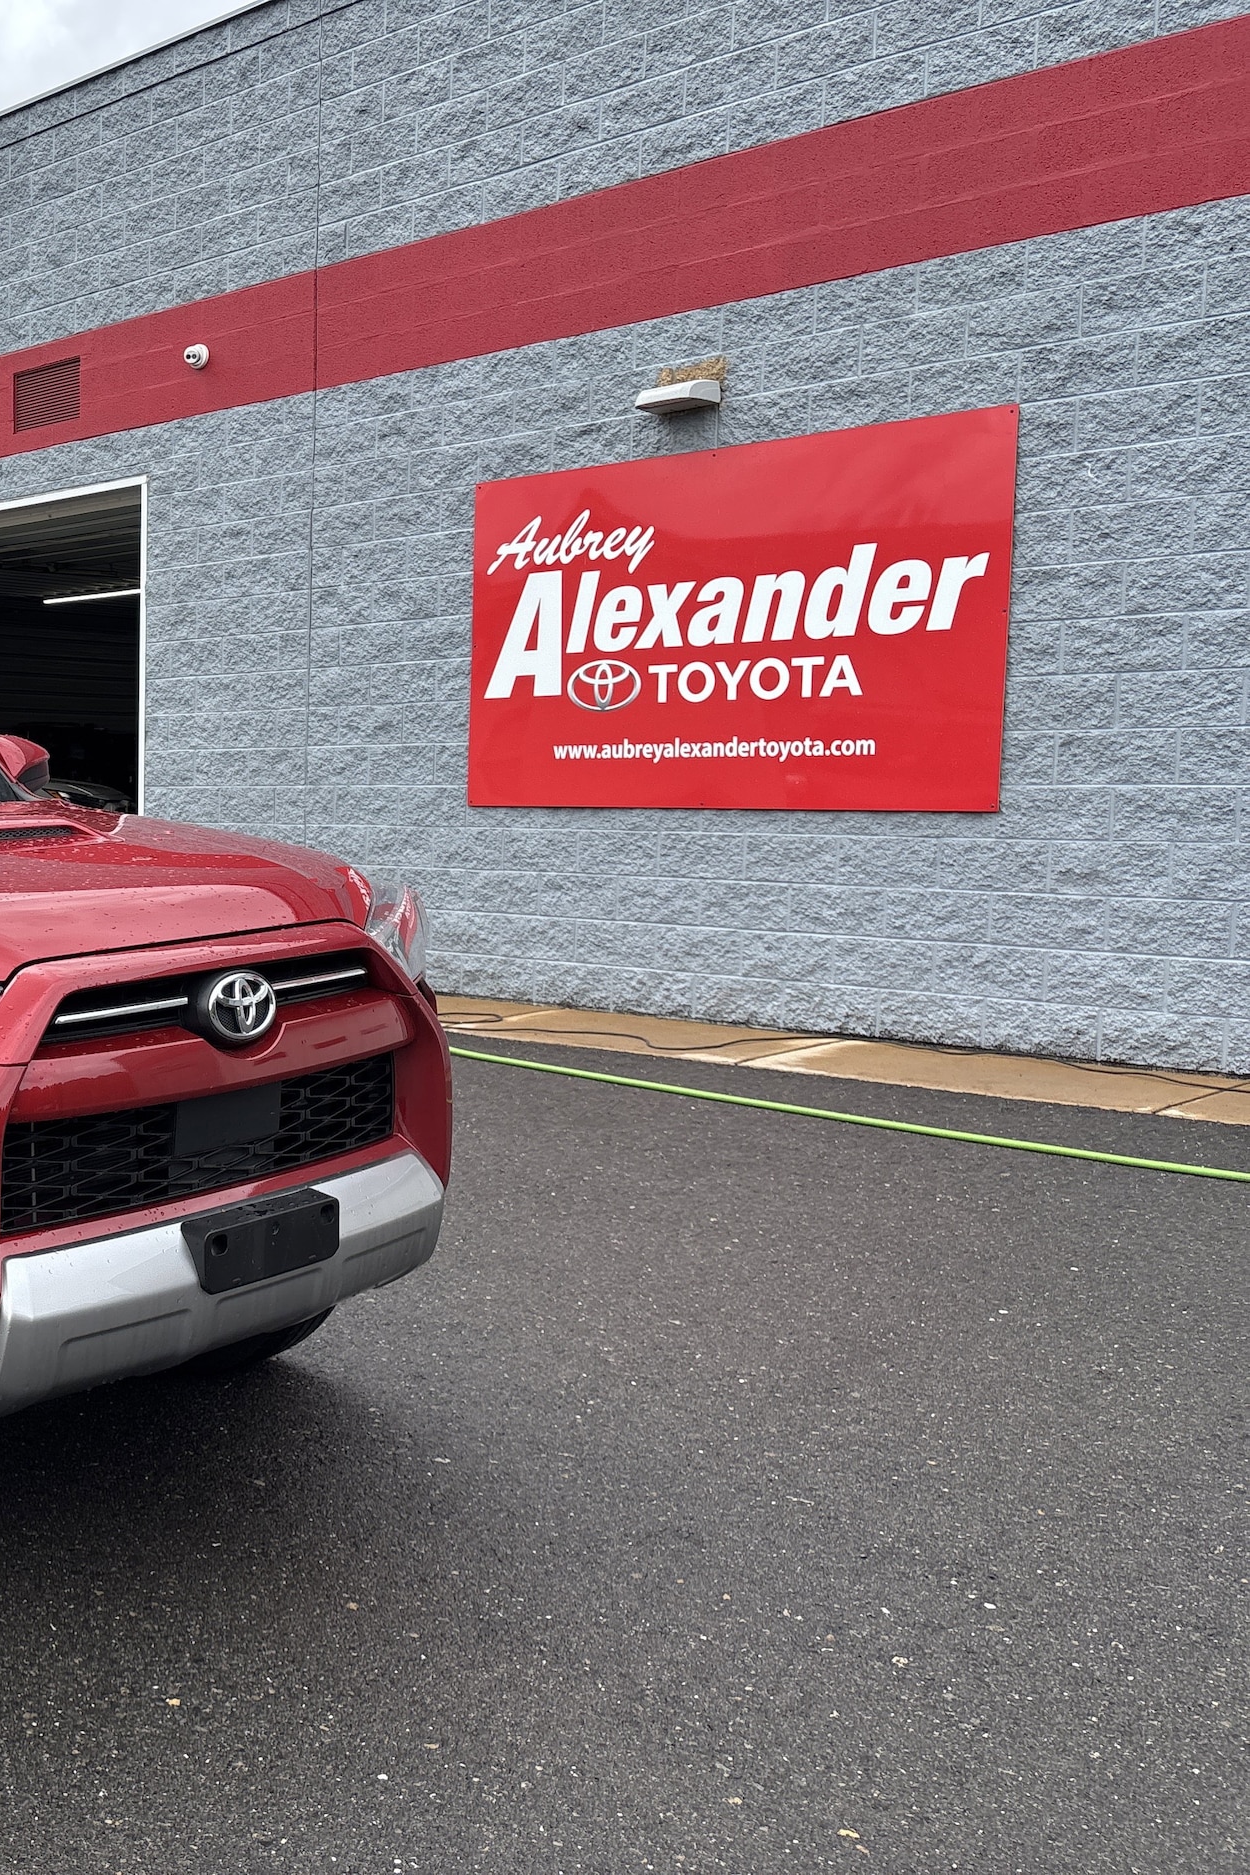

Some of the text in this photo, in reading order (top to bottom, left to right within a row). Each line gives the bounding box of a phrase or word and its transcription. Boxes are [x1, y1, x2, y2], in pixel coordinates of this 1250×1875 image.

[487, 509, 655, 575] Aubrey
[484, 542, 990, 699] Alexander
[648, 654, 863, 703] TOYOTA
[553, 736, 876, 764] www.aubreyalexandertoyota.com
